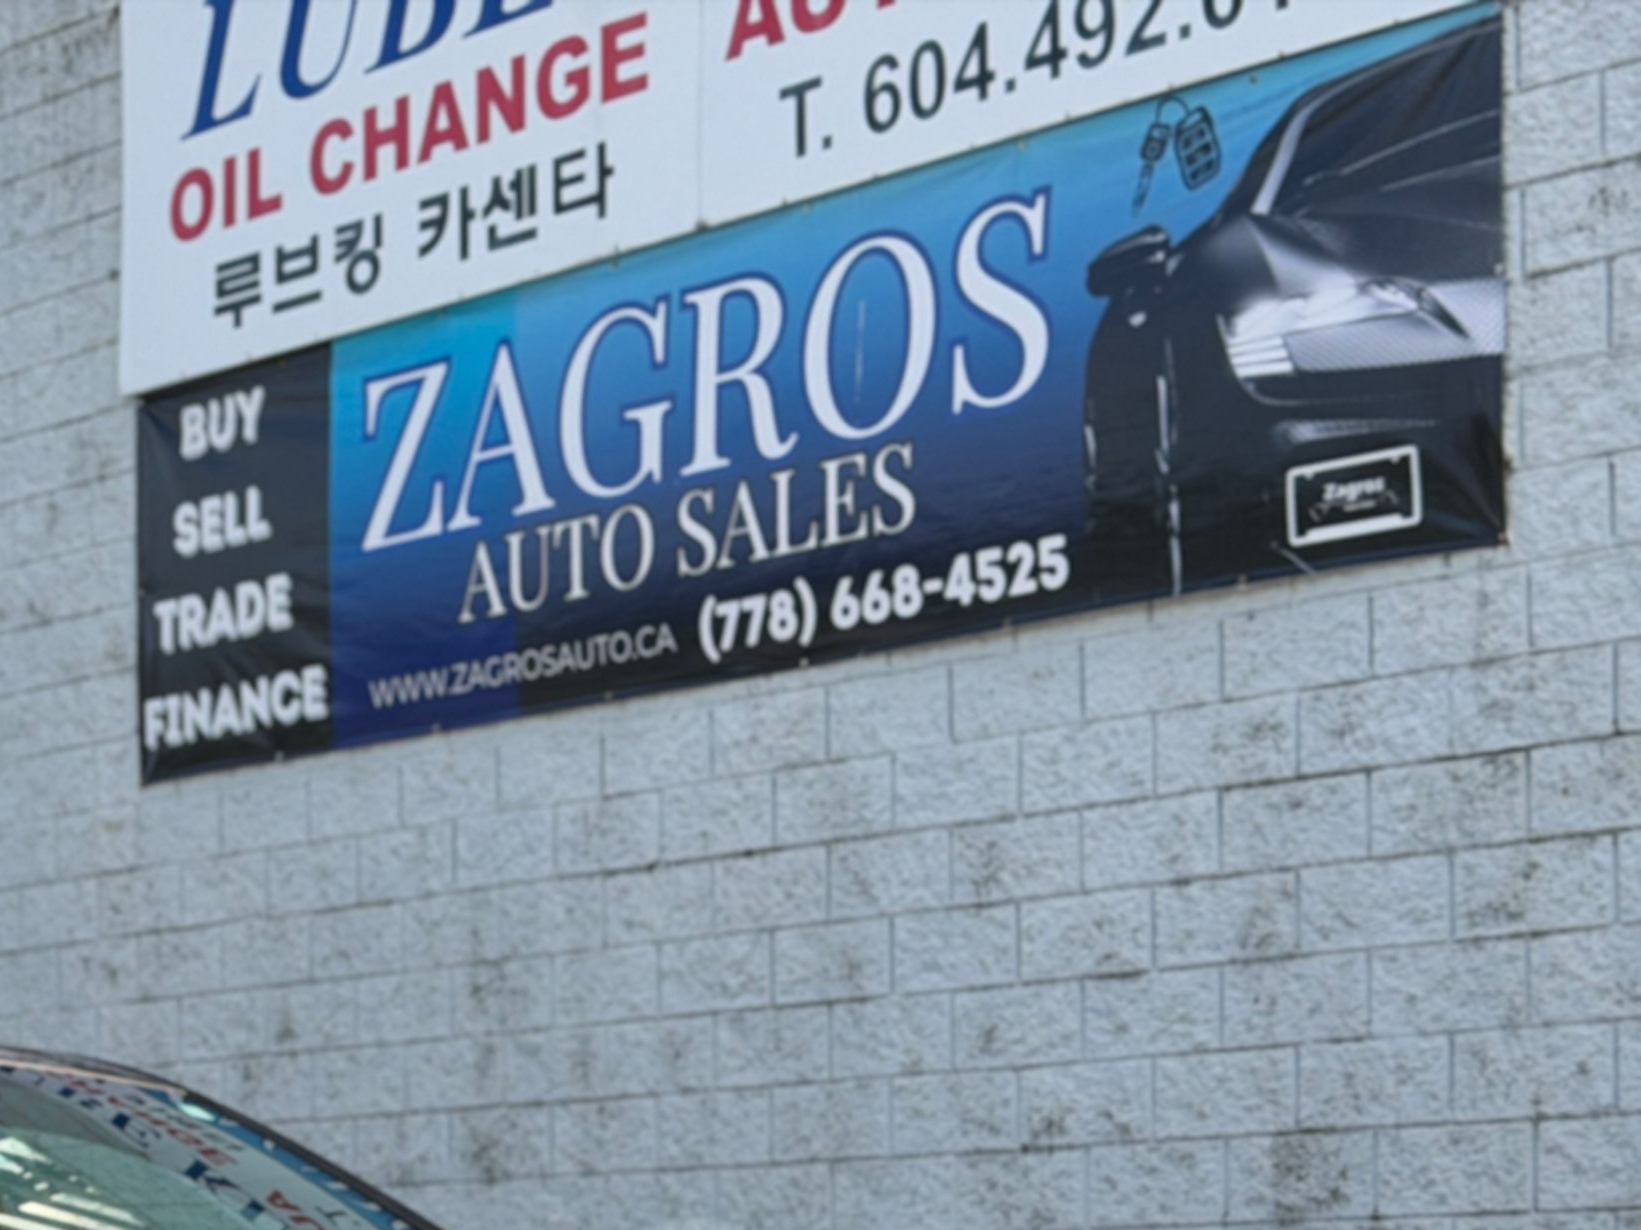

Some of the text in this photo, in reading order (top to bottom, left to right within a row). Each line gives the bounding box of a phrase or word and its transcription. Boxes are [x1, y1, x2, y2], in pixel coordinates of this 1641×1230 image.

[169, 147, 283, 242] OIL
[309, 12, 649, 196] CHANGE
[179, 0, 557, 141] LU
[779, 74, 833, 158] T.
[863, 0, 1290, 135] 604.492.
[213, 142, 614, 328] 루브킹 카센타
[179, 385, 266, 461] BUY
[361, 190, 1050, 553] ZAGROS
[172, 485, 272, 558] SELL
[458, 442, 916, 624] AUTO SALES
[153, 571, 294, 656] TRADE
[367, 621, 679, 709] WWW.ZAGROSAUTO.CA
[698, 533, 1071, 665] (778) 668-4525
[142, 663, 330, 751] FINANCE
